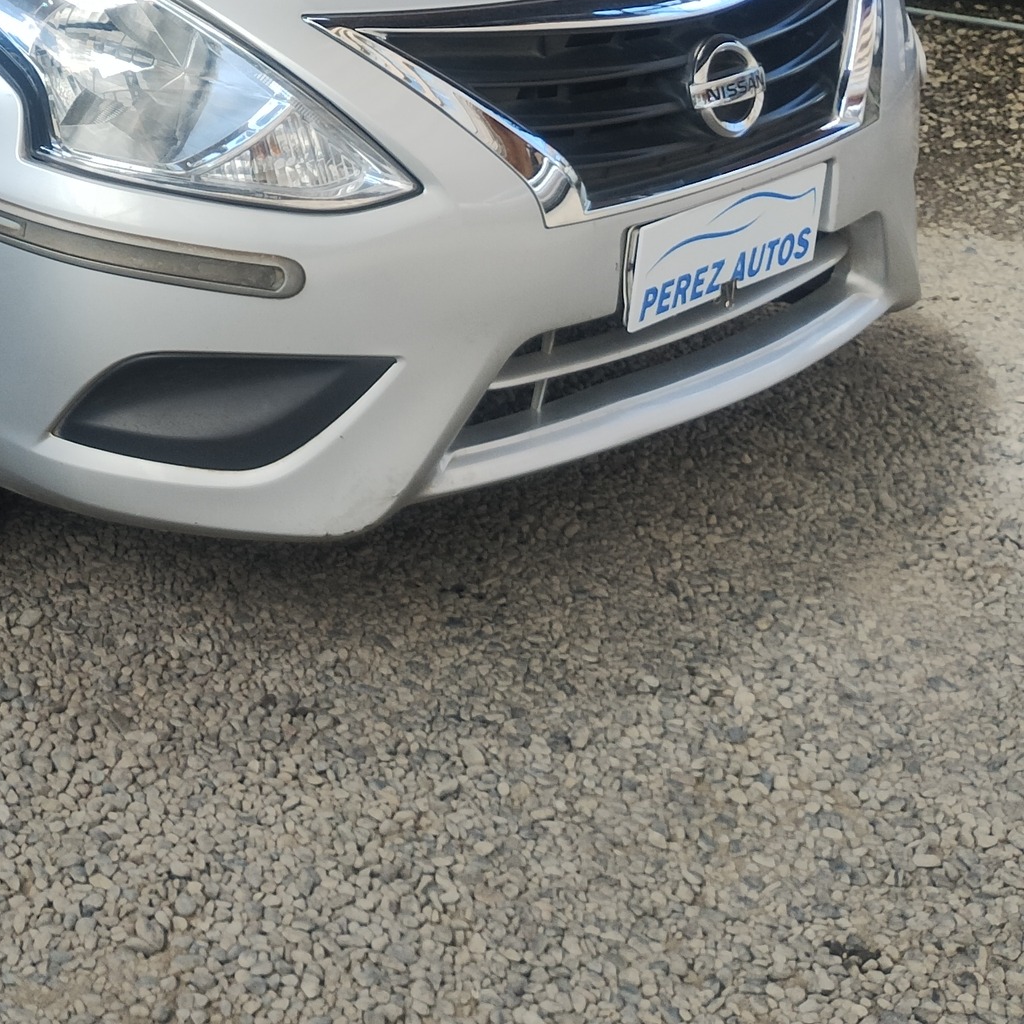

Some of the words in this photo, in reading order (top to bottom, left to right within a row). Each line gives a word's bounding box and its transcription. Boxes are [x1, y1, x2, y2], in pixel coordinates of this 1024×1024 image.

[705, 73, 765, 103] NISSAN
[638, 259, 726, 323] PEREZ
[730, 227, 812, 282] AUTOS
